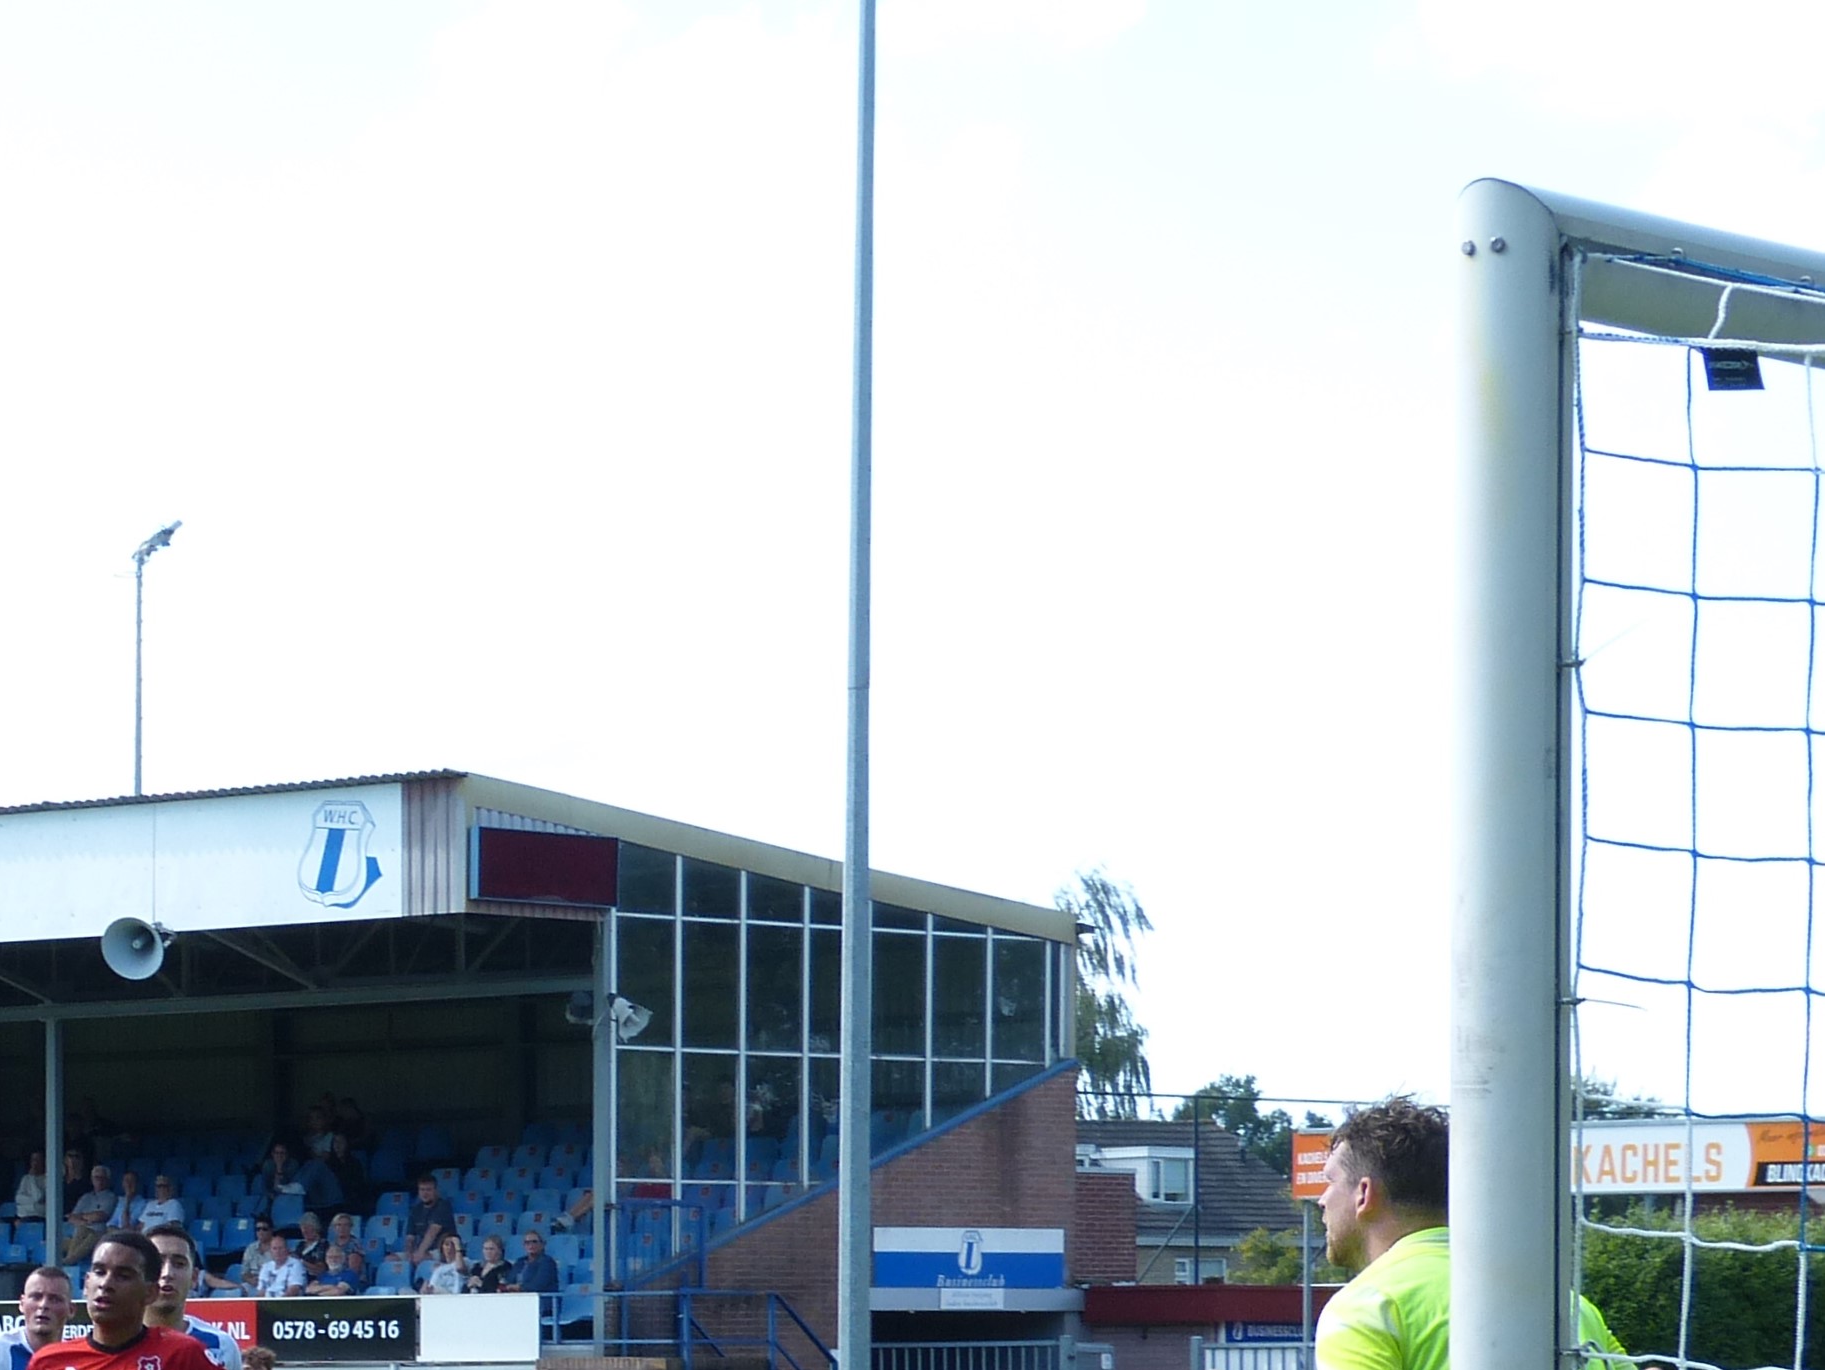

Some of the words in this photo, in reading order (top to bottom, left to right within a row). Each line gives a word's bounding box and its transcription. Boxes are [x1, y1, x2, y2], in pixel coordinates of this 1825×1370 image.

[272, 1321, 316, 1340] 0578
[327, 1321, 350, 1339] 69
[352, 1321, 374, 1339] 45
[378, 1320, 400, 1339] 16
